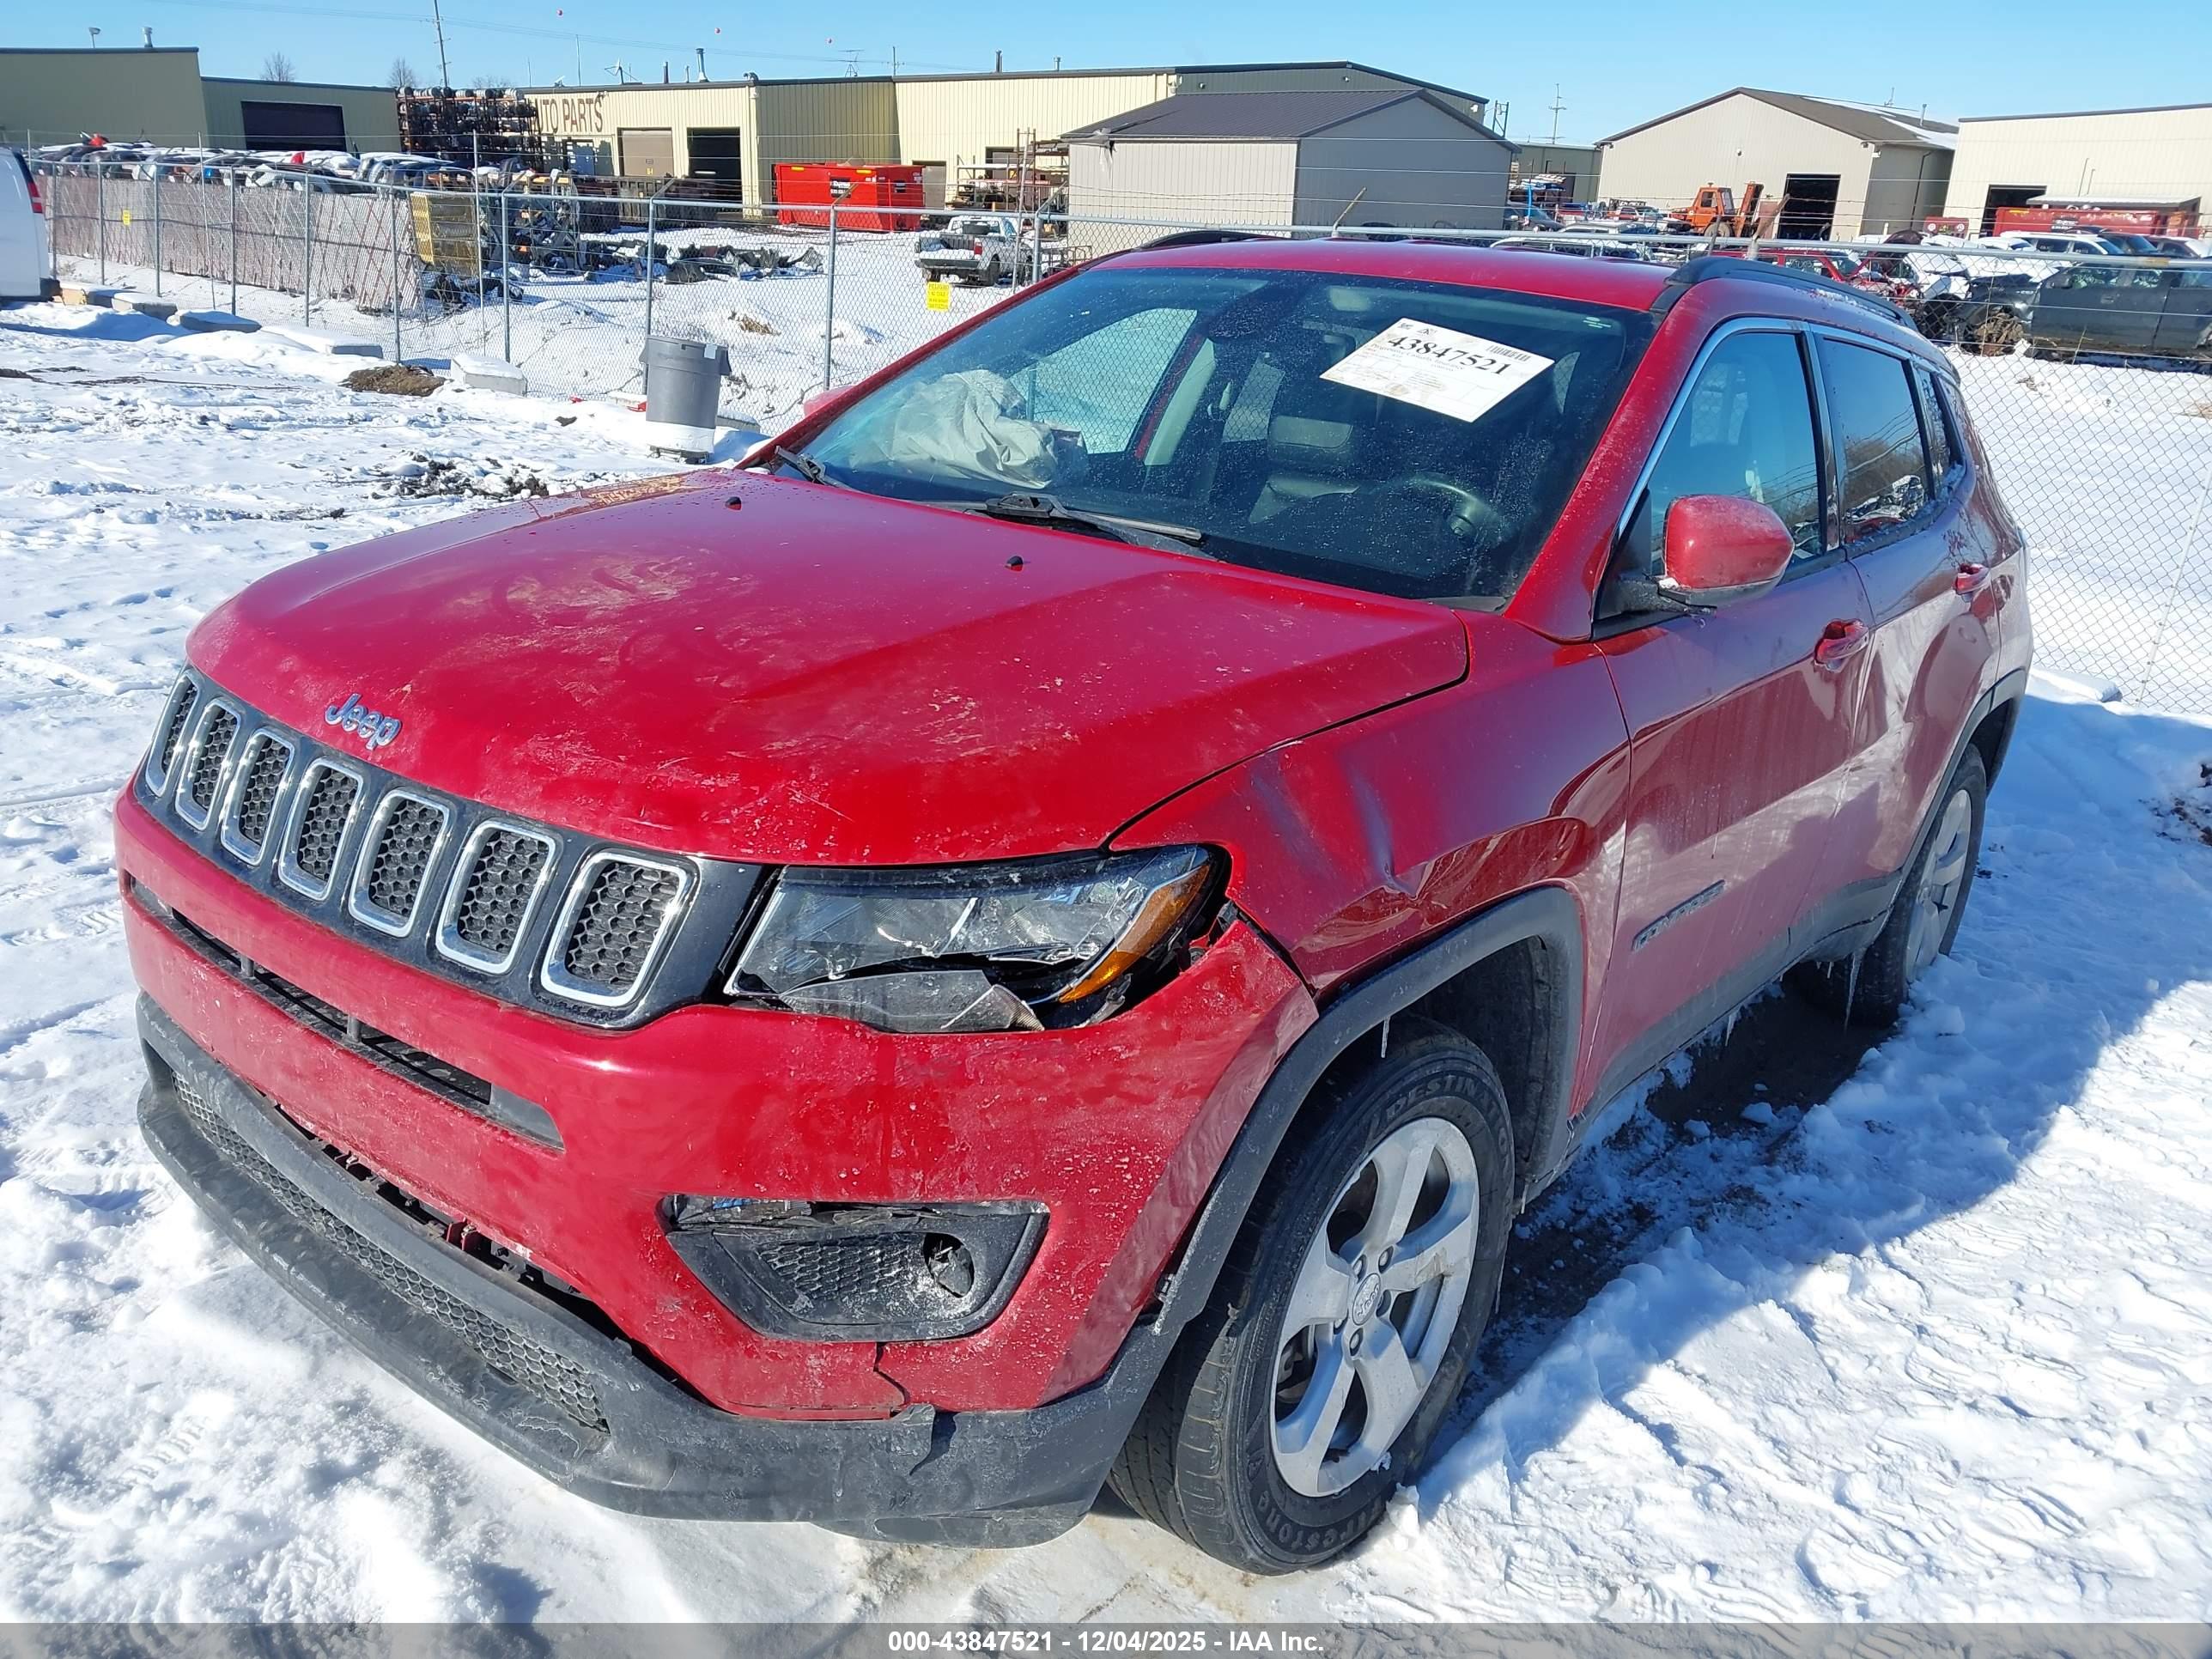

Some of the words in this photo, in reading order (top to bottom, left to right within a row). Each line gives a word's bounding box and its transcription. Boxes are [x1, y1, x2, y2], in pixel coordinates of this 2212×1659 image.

[562, 94, 604, 132] PARTS
[1388, 336, 1511, 375] 43847521
[325, 693, 401, 750] Jeep
